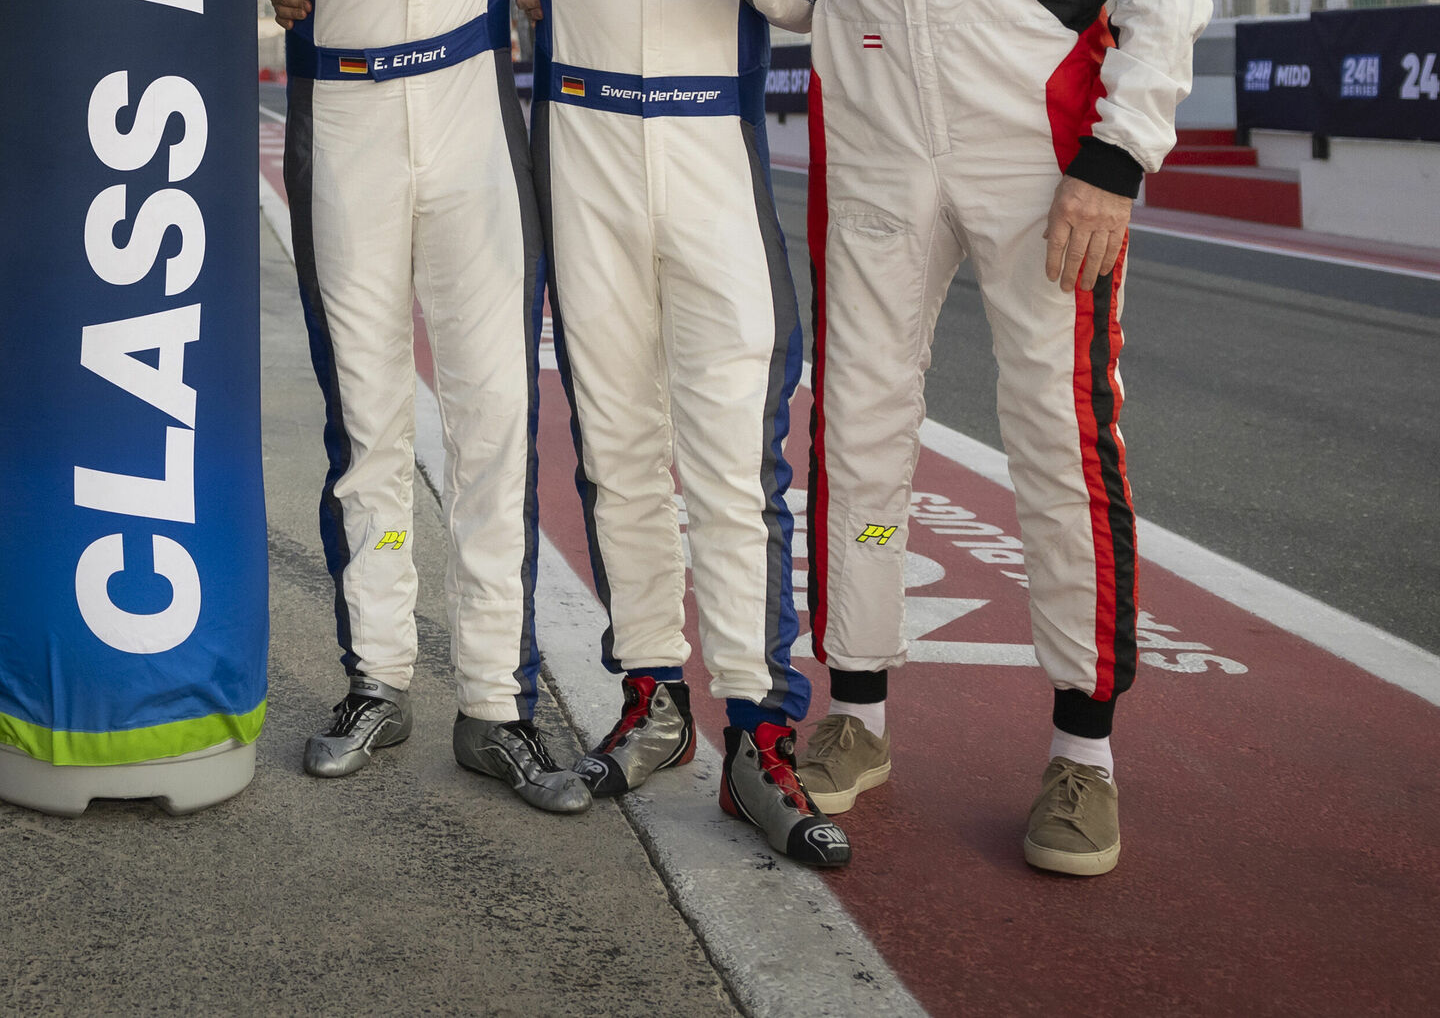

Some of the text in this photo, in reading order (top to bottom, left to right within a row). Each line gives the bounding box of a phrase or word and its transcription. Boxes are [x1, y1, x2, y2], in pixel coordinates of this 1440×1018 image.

[373, 45, 447, 71] E. Erhart
[1247, 60, 1273, 80] 24H
[1343, 56, 1380, 84] 24H
[648, 87, 721, 104] Herberger
[74, 70, 210, 655] CLASS
